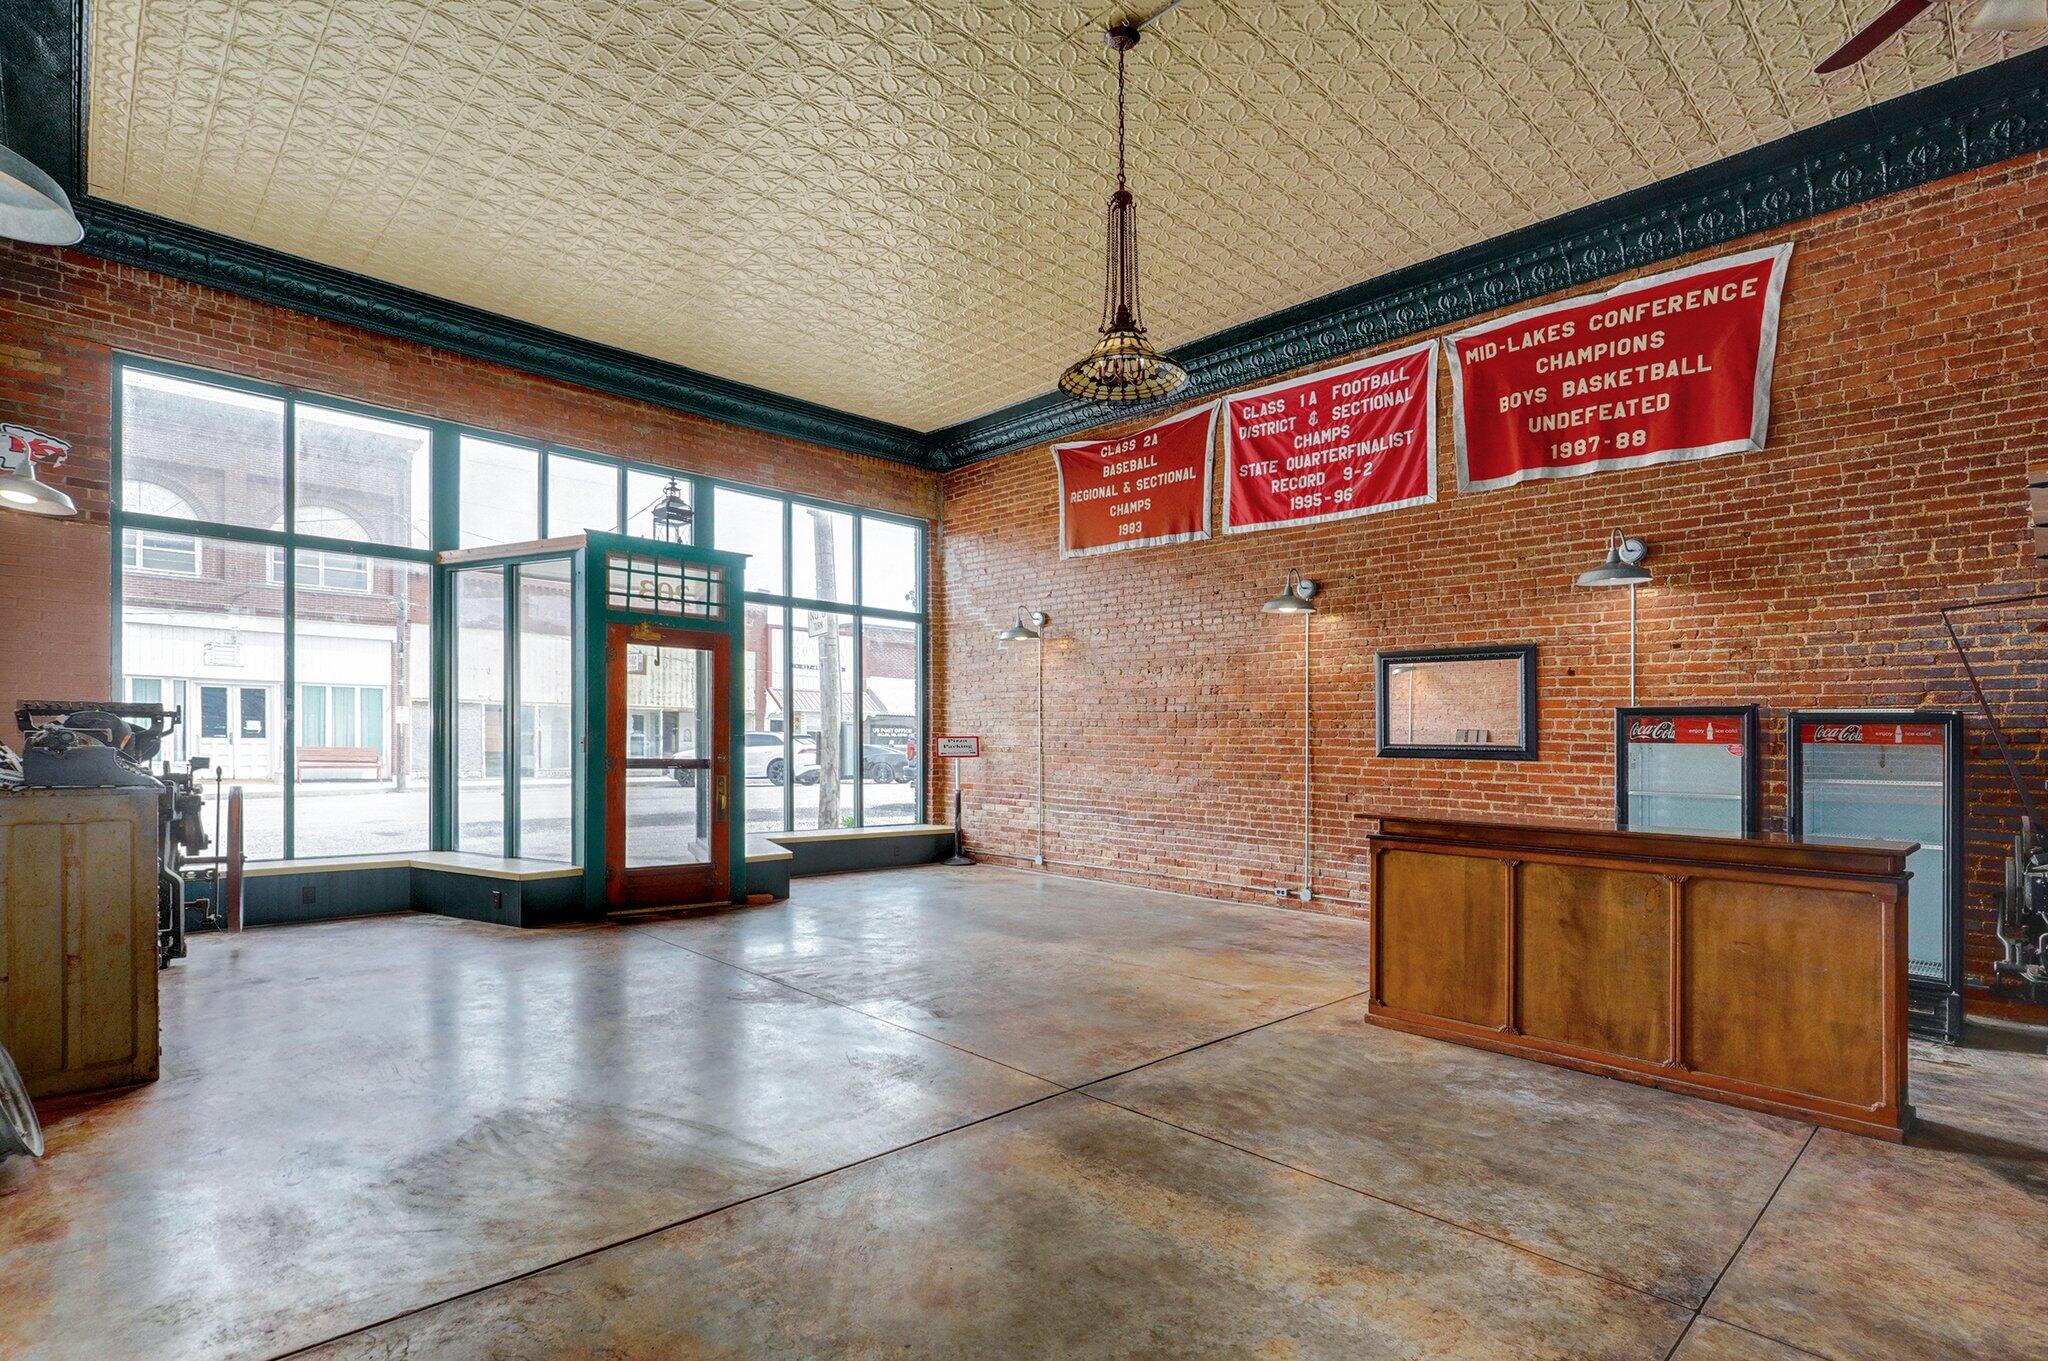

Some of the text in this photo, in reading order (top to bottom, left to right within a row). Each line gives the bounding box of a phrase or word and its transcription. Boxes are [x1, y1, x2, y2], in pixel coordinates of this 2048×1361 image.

[1465, 277, 1758, 365] MID-LAKES CONFERENCE
[1535, 330, 1665, 374] CHAMPIONS
[1243, 399, 1285, 420] CLASS
[1331, 366, 1409, 400] FOOTBALL
[1499, 354, 1712, 413] BOYS BASKETBALL
[1239, 387, 1413, 440] DISTRICT & SECTIONAL
[1528, 393, 1670, 433] UNDEFEATED
[1100, 433, 1158, 458] CLASS 2A
[1239, 429, 1413, 477] STATE QUARTERFINALIST
[1293, 424, 1350, 449] CHAMPS
[1070, 466, 1196, 503] REGIONAL & SECTIONAL
[1103, 454, 1158, 478] BASEBALL
[1271, 472, 1325, 493] RECORD
[1109, 498, 1151, 517] CHAMPS
[1118, 521, 1142, 536] 1983
